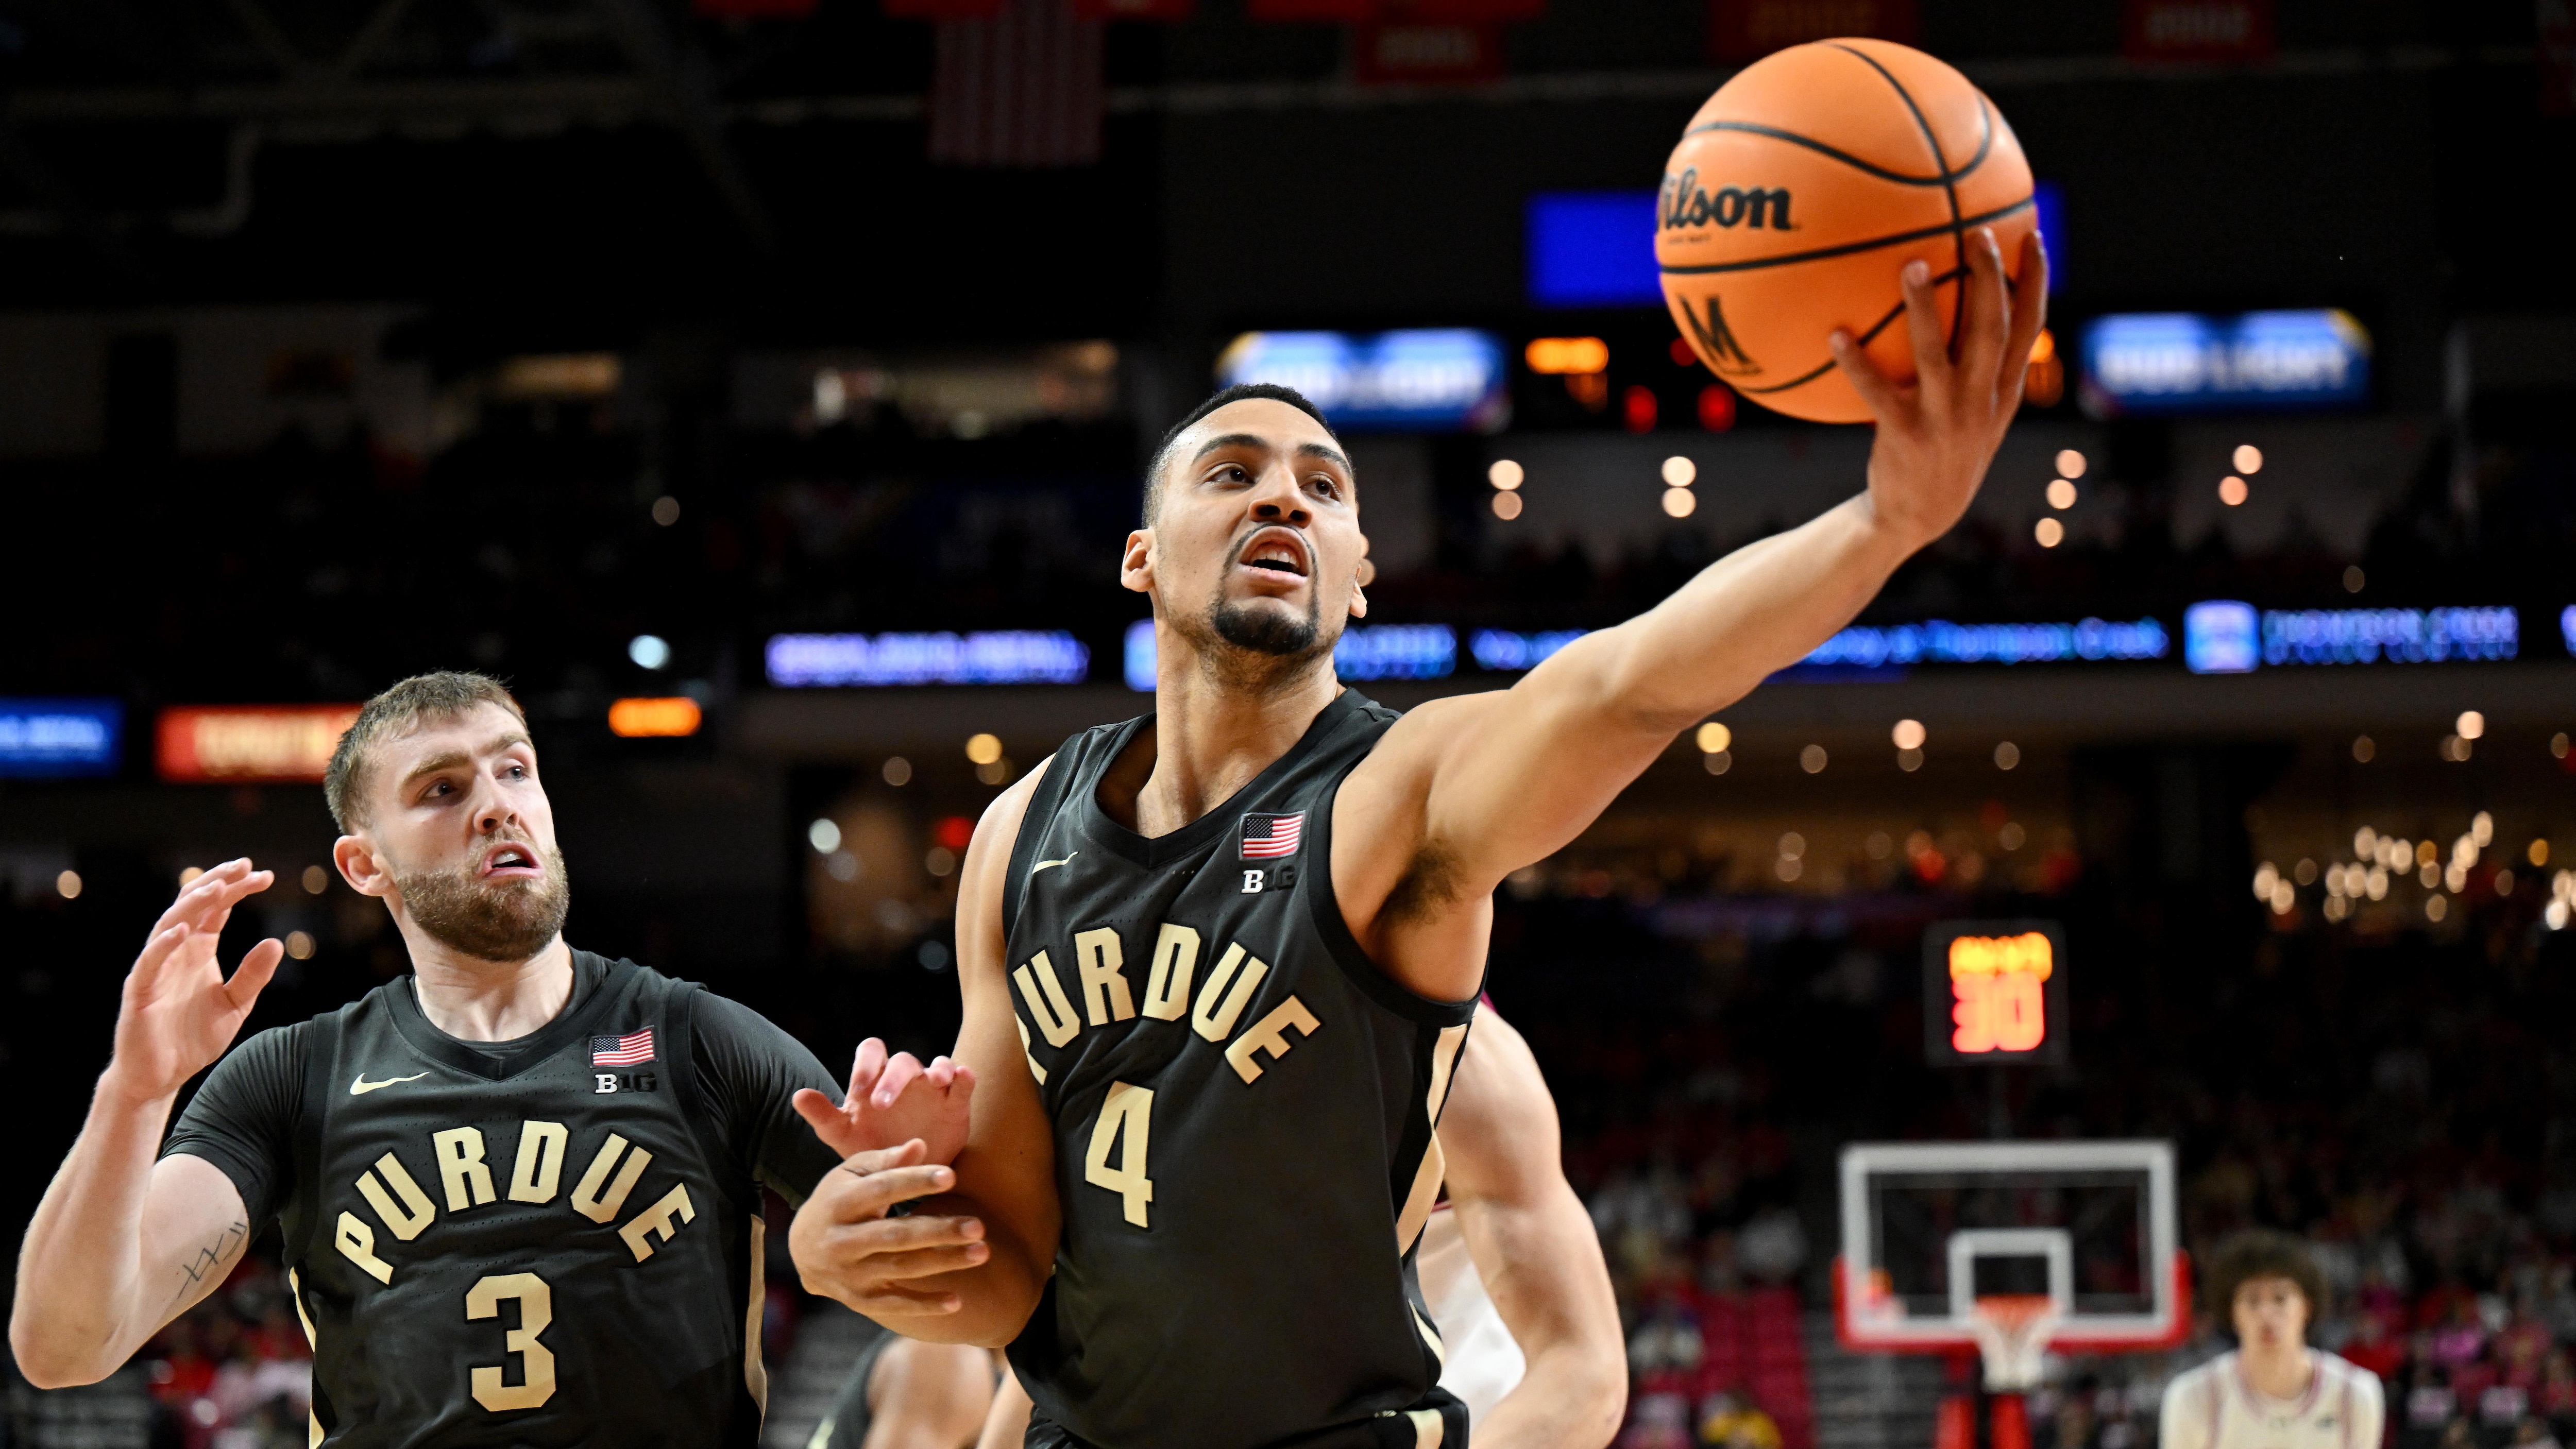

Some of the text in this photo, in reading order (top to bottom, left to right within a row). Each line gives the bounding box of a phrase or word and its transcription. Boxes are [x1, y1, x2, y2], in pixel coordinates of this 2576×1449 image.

[1653, 166, 1791, 230] ilson
[1013, 923, 1320, 1086] URDUE
[335, 1120, 695, 1285] PURDUE
[1085, 1081, 1154, 1228] 4
[466, 1272, 556, 1412] 3
